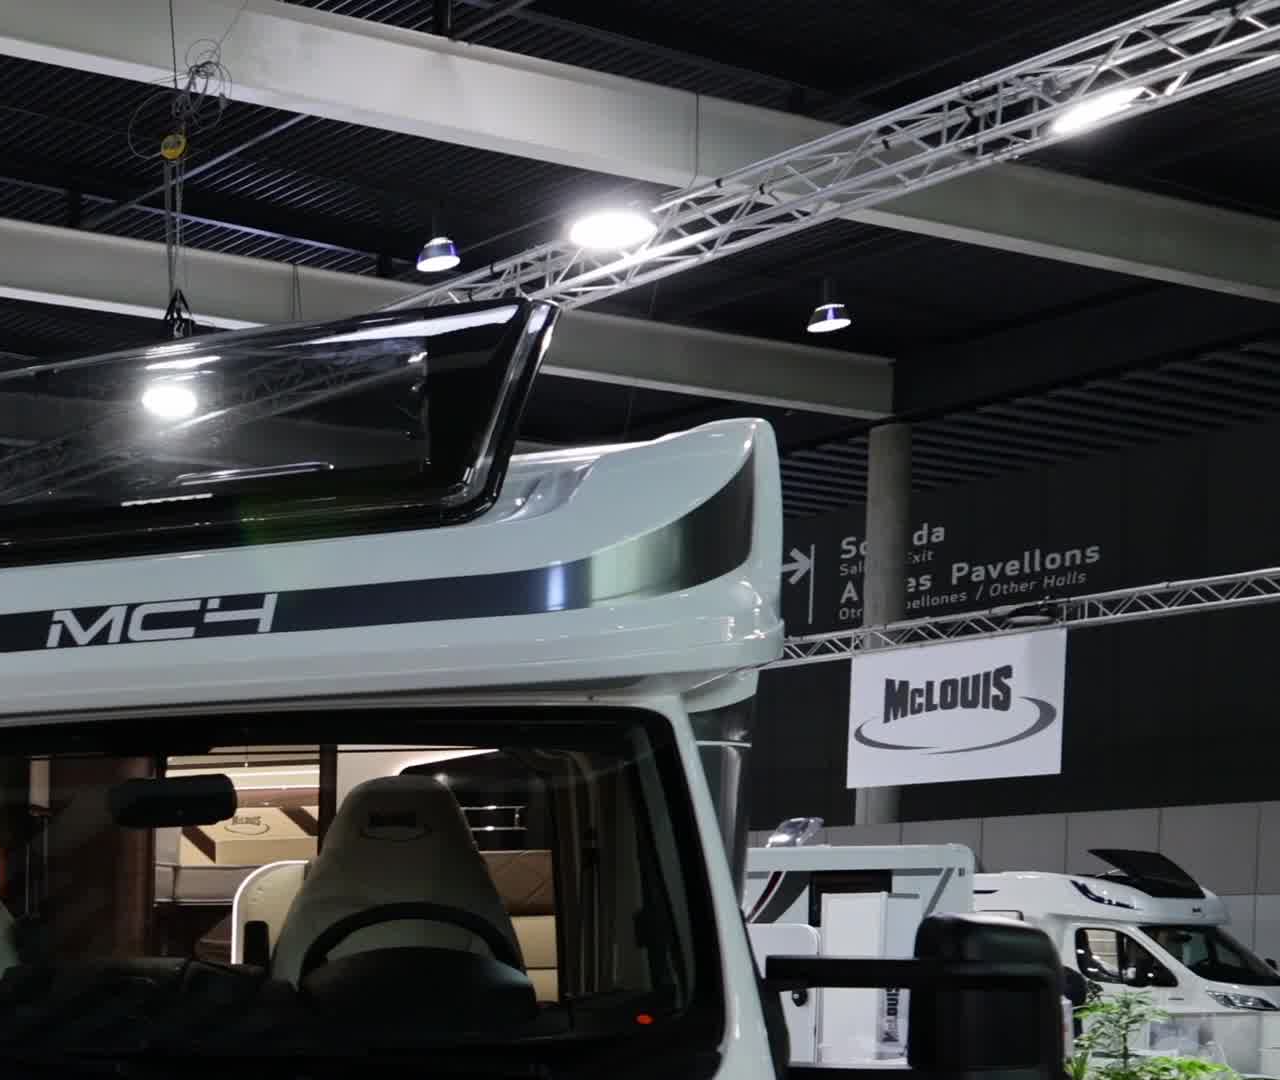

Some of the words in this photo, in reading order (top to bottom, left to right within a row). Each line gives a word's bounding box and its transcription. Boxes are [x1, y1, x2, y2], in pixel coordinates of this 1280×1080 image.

[951, 545, 1100, 585] Pavellons
[990, 581, 1039, 597] Other
[1043, 571, 1088, 589] Halls
[46, 593, 278, 648] MC4
[883, 664, 1013, 724] McLOUIS
